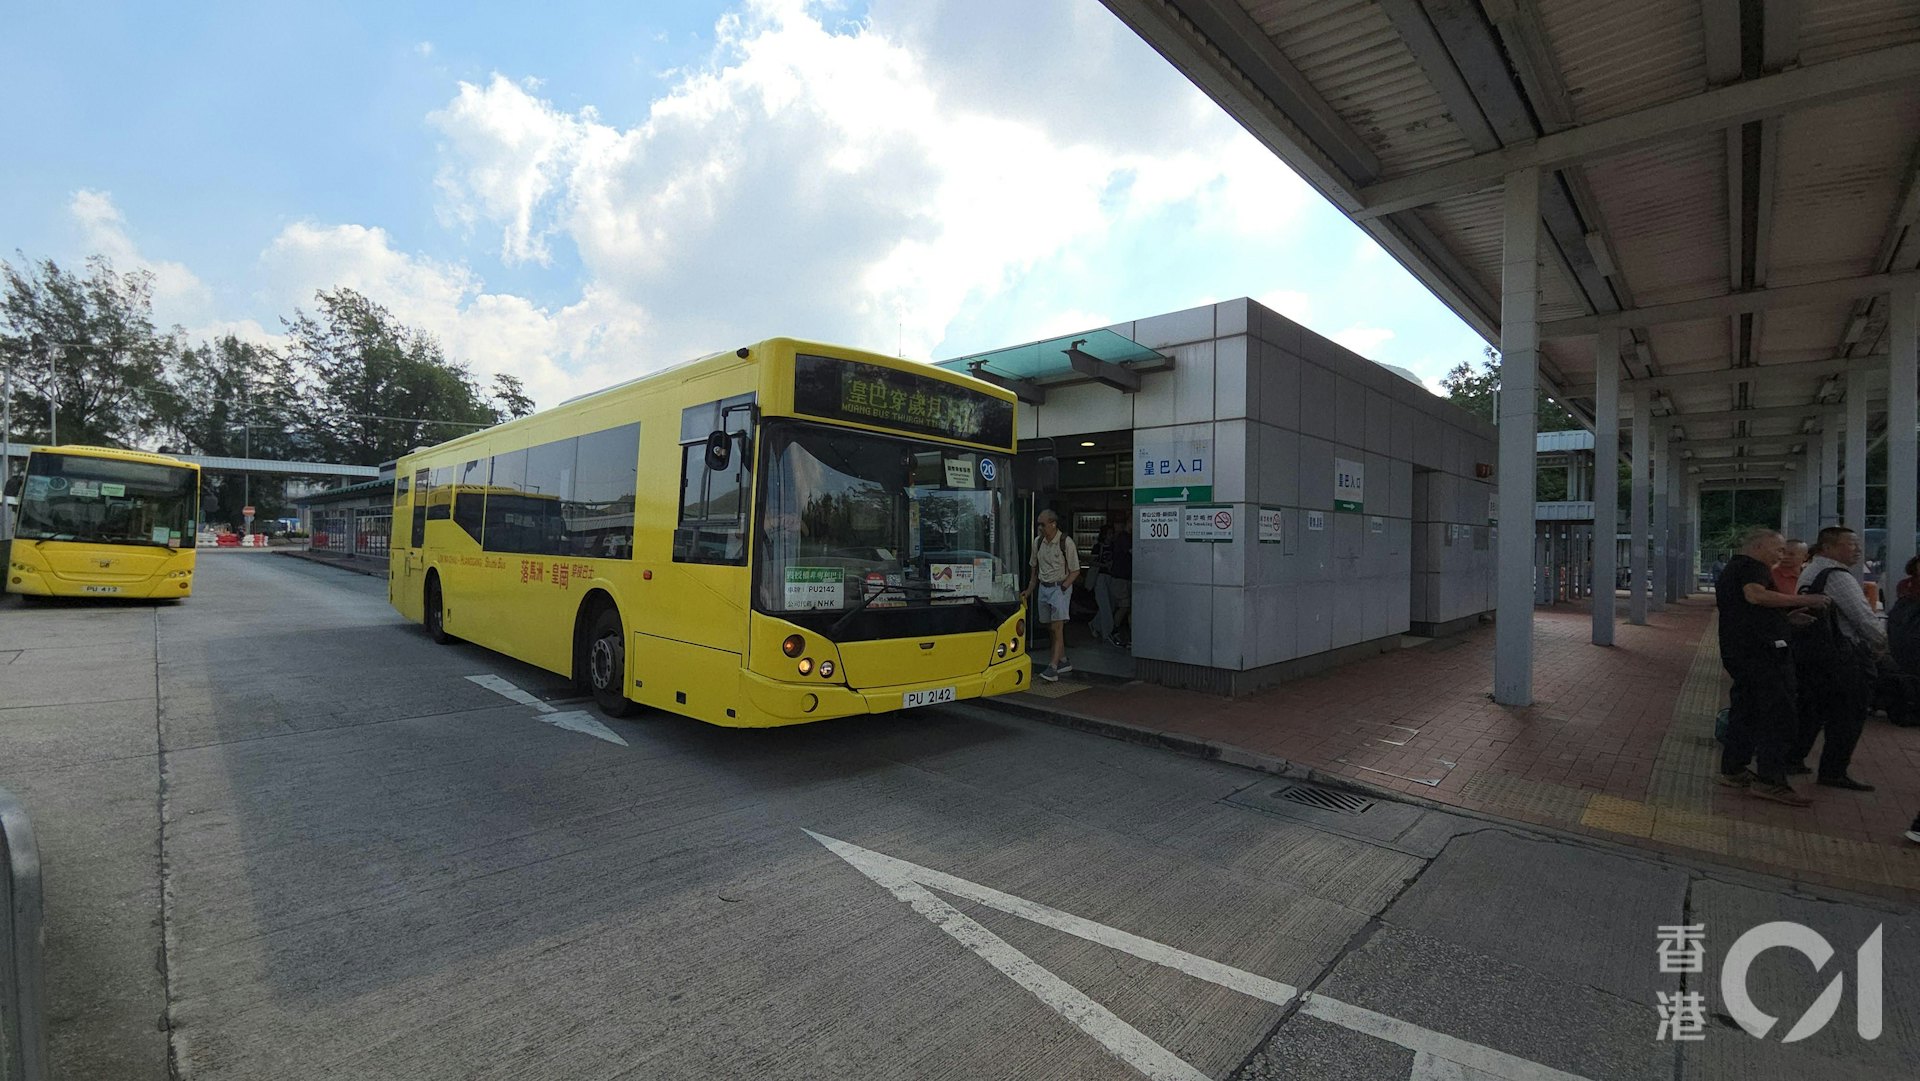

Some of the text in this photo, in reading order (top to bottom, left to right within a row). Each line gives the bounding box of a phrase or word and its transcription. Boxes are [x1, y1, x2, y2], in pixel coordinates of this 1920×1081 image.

[982, 463, 995, 476] 20
[1143, 458, 1202, 476] 皇巴入口
[1150, 523, 1169, 538] 300
[808, 585, 835, 593] PU2142
[817, 599, 835, 607] NHK
[907, 689, 951, 706] PU 2142
